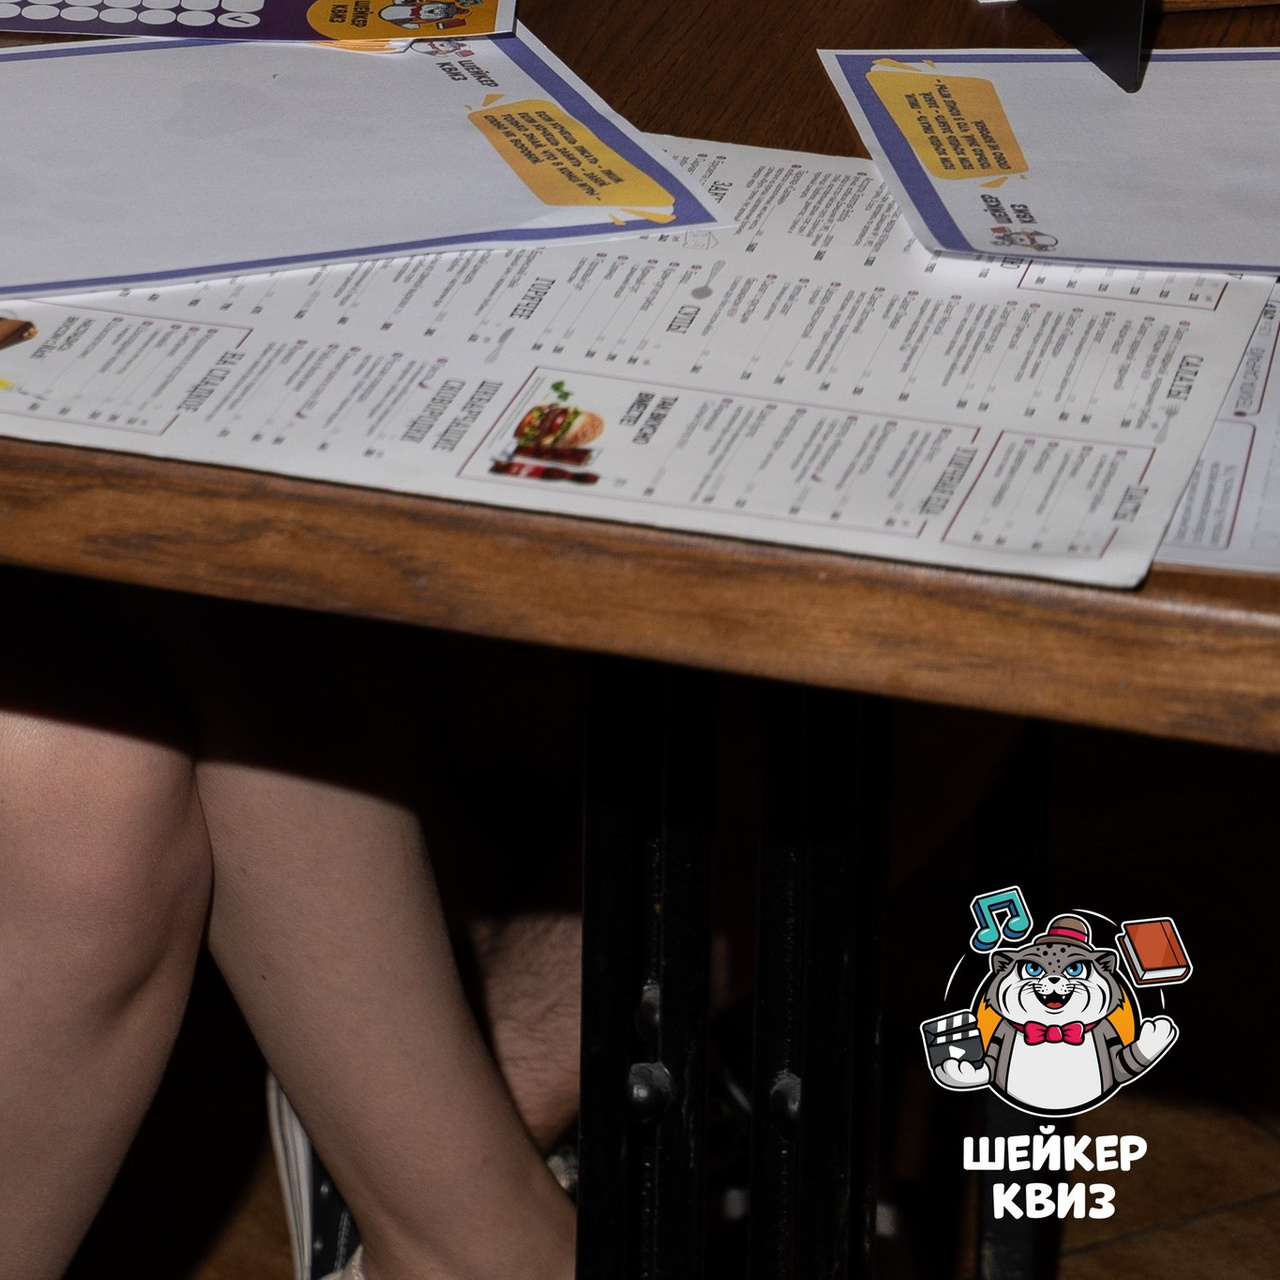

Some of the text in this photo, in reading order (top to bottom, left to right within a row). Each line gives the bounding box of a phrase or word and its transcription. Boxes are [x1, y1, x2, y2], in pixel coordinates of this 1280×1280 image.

[329, 4, 348, 23] КВИЗ
[351, 0, 372, 27] ШЕЙКЕР
[437, 62, 467, 81] КВИЗ
[458, 60, 498, 87] ШЕЙКЕР
[935, 84, 951, 98] ИГРЫ
[943, 100, 961, 116] КОНЦЕ
[484, 115, 508, 130] СЛОВО
[917, 116, 934, 134] ПИСАТЬ
[935, 115, 953, 134] ЗАБИТЬ
[956, 122, 970, 132] ЧТО
[518, 112, 538, 123] ЕСЛИ
[532, 124, 559, 146] ХОЧЕШЬ
[556, 147, 582, 167] ЗАБИТЬ
[535, 111, 555, 122] ЕСЛИ
[549, 122, 577, 144] ХОЧЕШЬ
[574, 145, 598, 164] ПИСАТЬ
[928, 135, 947, 155] ХОЧЕШЬ
[947, 135, 966, 155] ХОЧЕШЬ
[501, 114, 529, 131] ТОЛЬКО
[541, 150, 558, 160] ЧТО
[557, 167, 583, 183] КОНЦЕ
[577, 183, 599, 196] ИГРЫ
[940, 157, 955, 170] ЕСЛИ
[958, 157, 974, 170] ЕСЛИ
[972, 148, 991, 169] ТОЛЬКО
[992, 152, 1011, 169] СЛОВО
[981, 194, 1012, 223] ШЕЙКЕР
[1010, 204, 1036, 223] КВИЗ
[510, 278, 555, 319] ГОРЯЧЕЕ
[666, 306, 700, 333] СУПЫ
[216, 351, 245, 365] НА
[1167, 356, 1203, 400] САЛАТЫ
[177, 369, 229, 411] СЛАДКОЕ
[402, 380, 464, 442] СКОВОРОДКИ
[434, 381, 501, 450] ШКВАРЧАЩИЕ
[653, 397, 678, 414] ТАК
